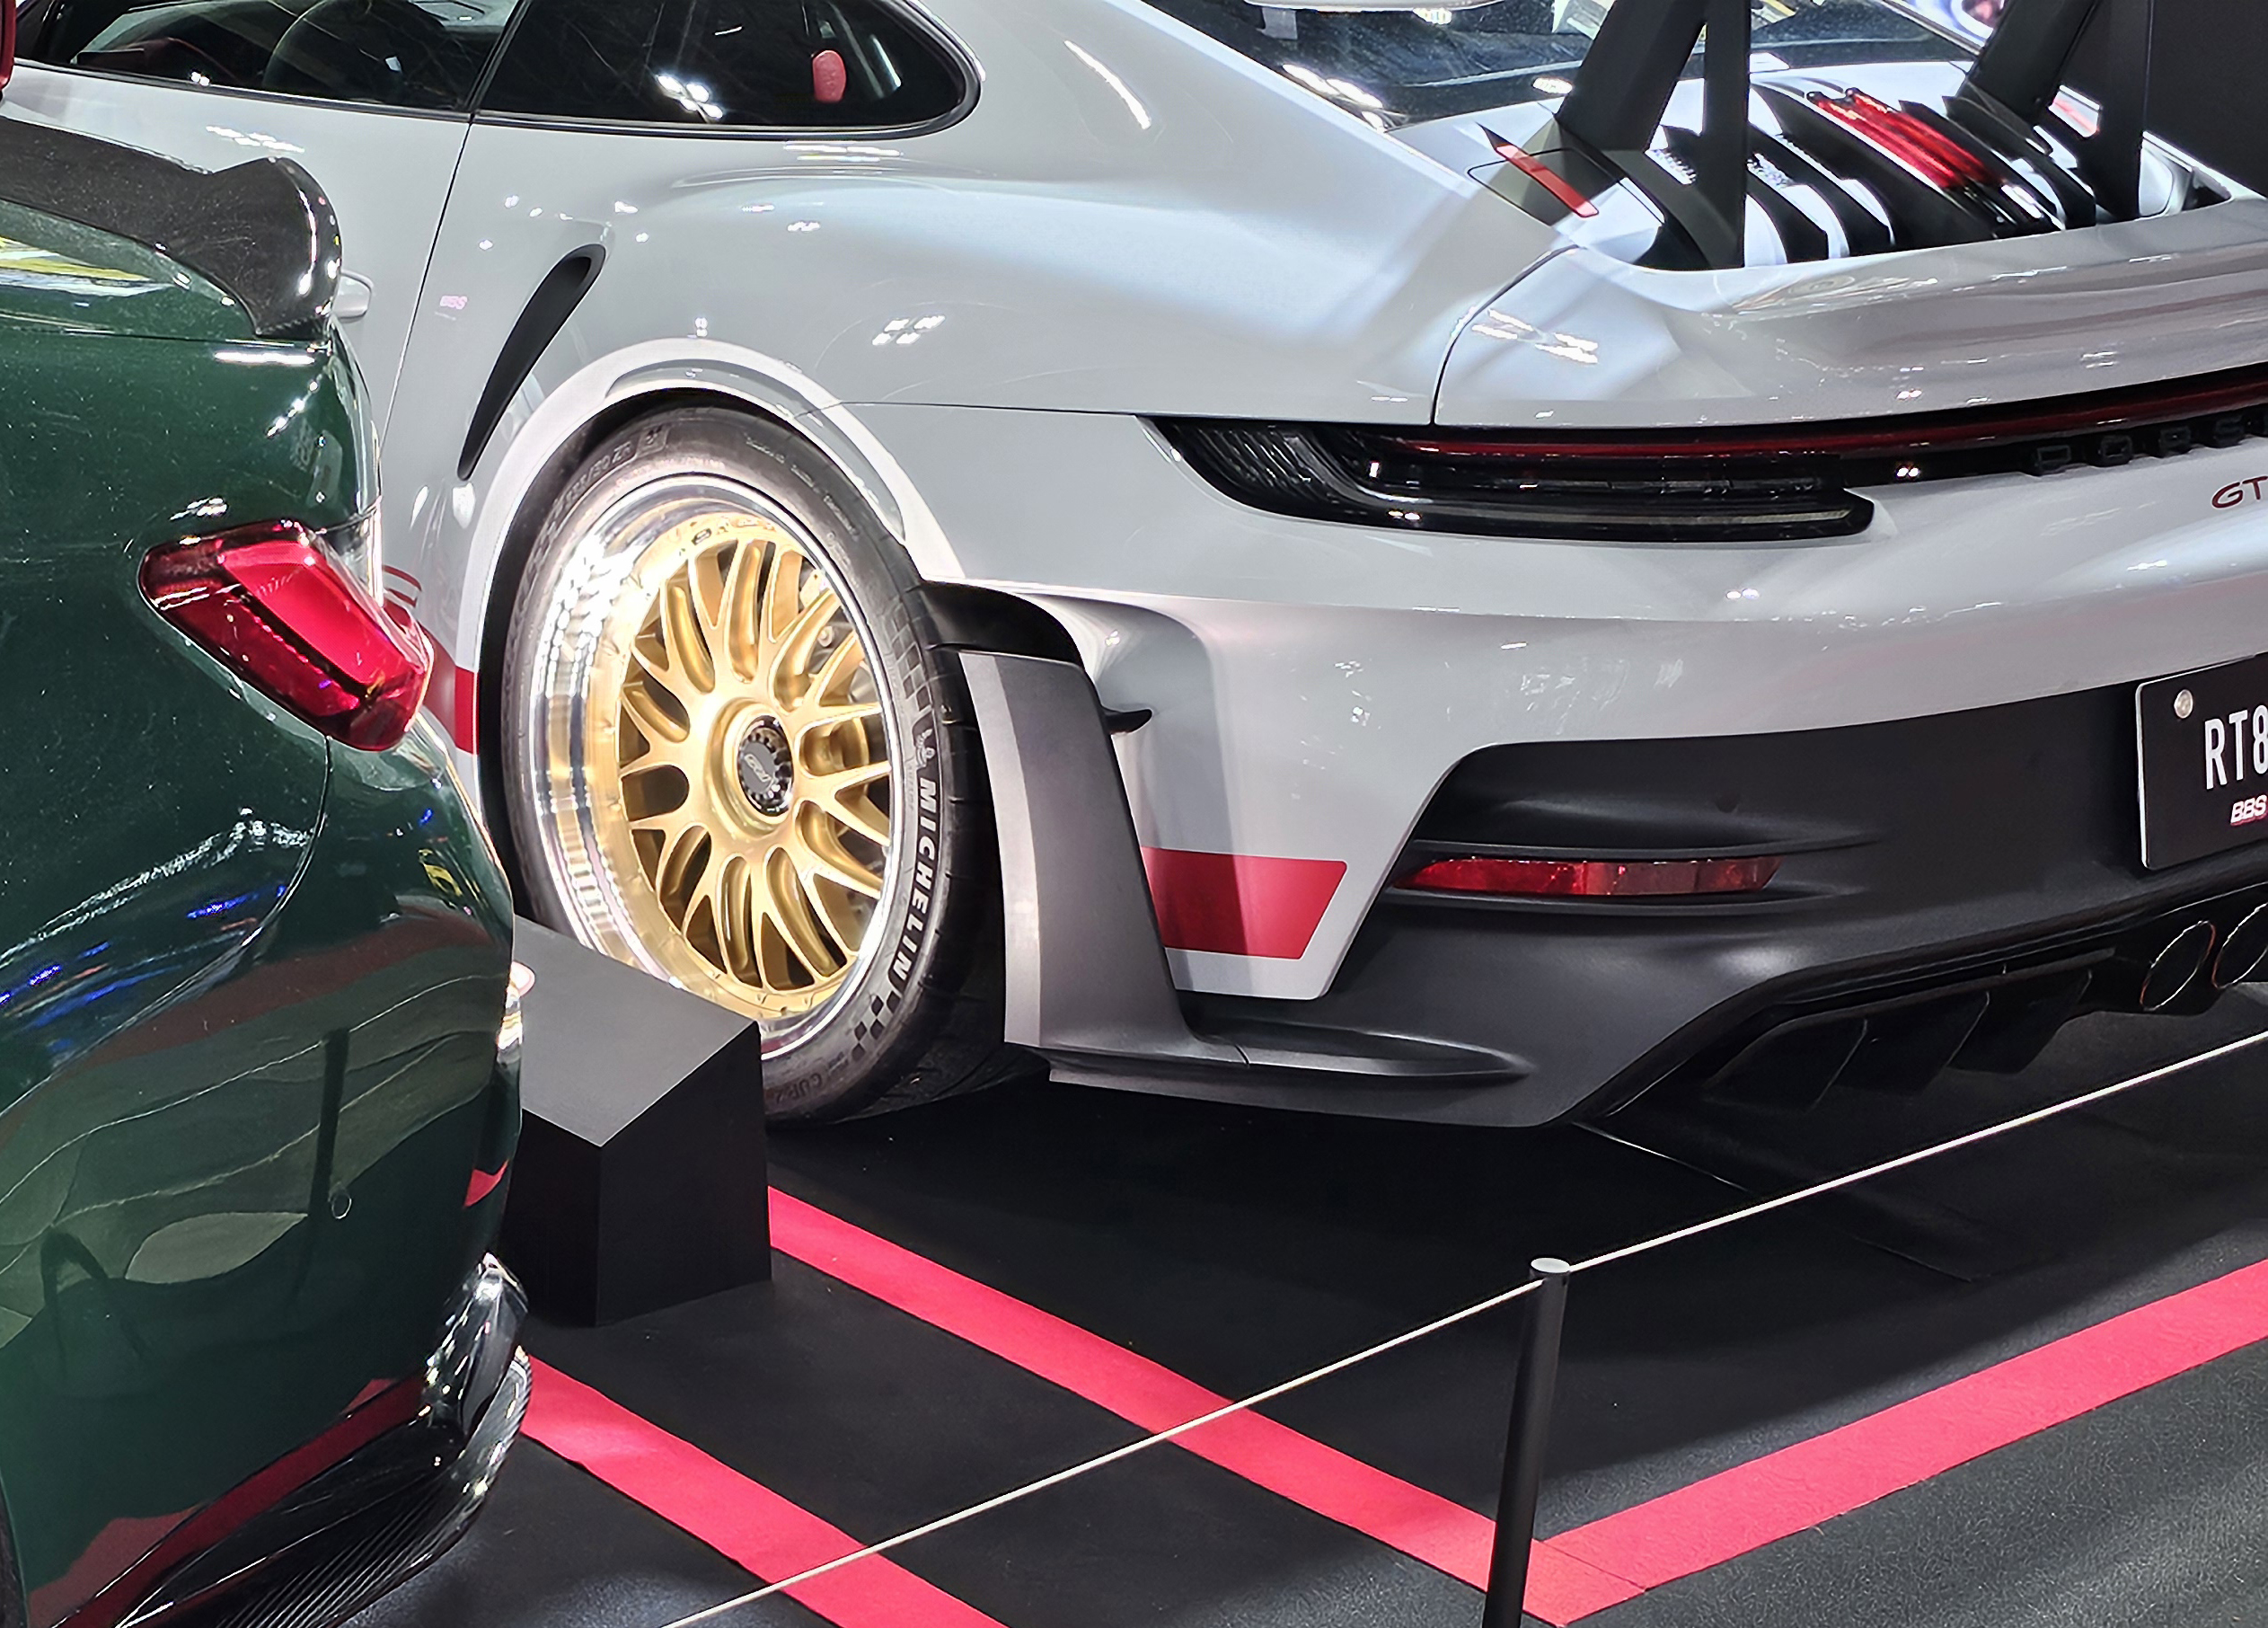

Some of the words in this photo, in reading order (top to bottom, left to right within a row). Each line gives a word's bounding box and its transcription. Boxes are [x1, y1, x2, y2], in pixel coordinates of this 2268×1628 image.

[2035, 413, 2268, 473] PORS
[2211, 475, 2268, 509] GT
[2204, 704, 2268, 791] RT8
[2229, 794, 2268, 826] BBS
[893, 776, 938, 981] MICHELIN
